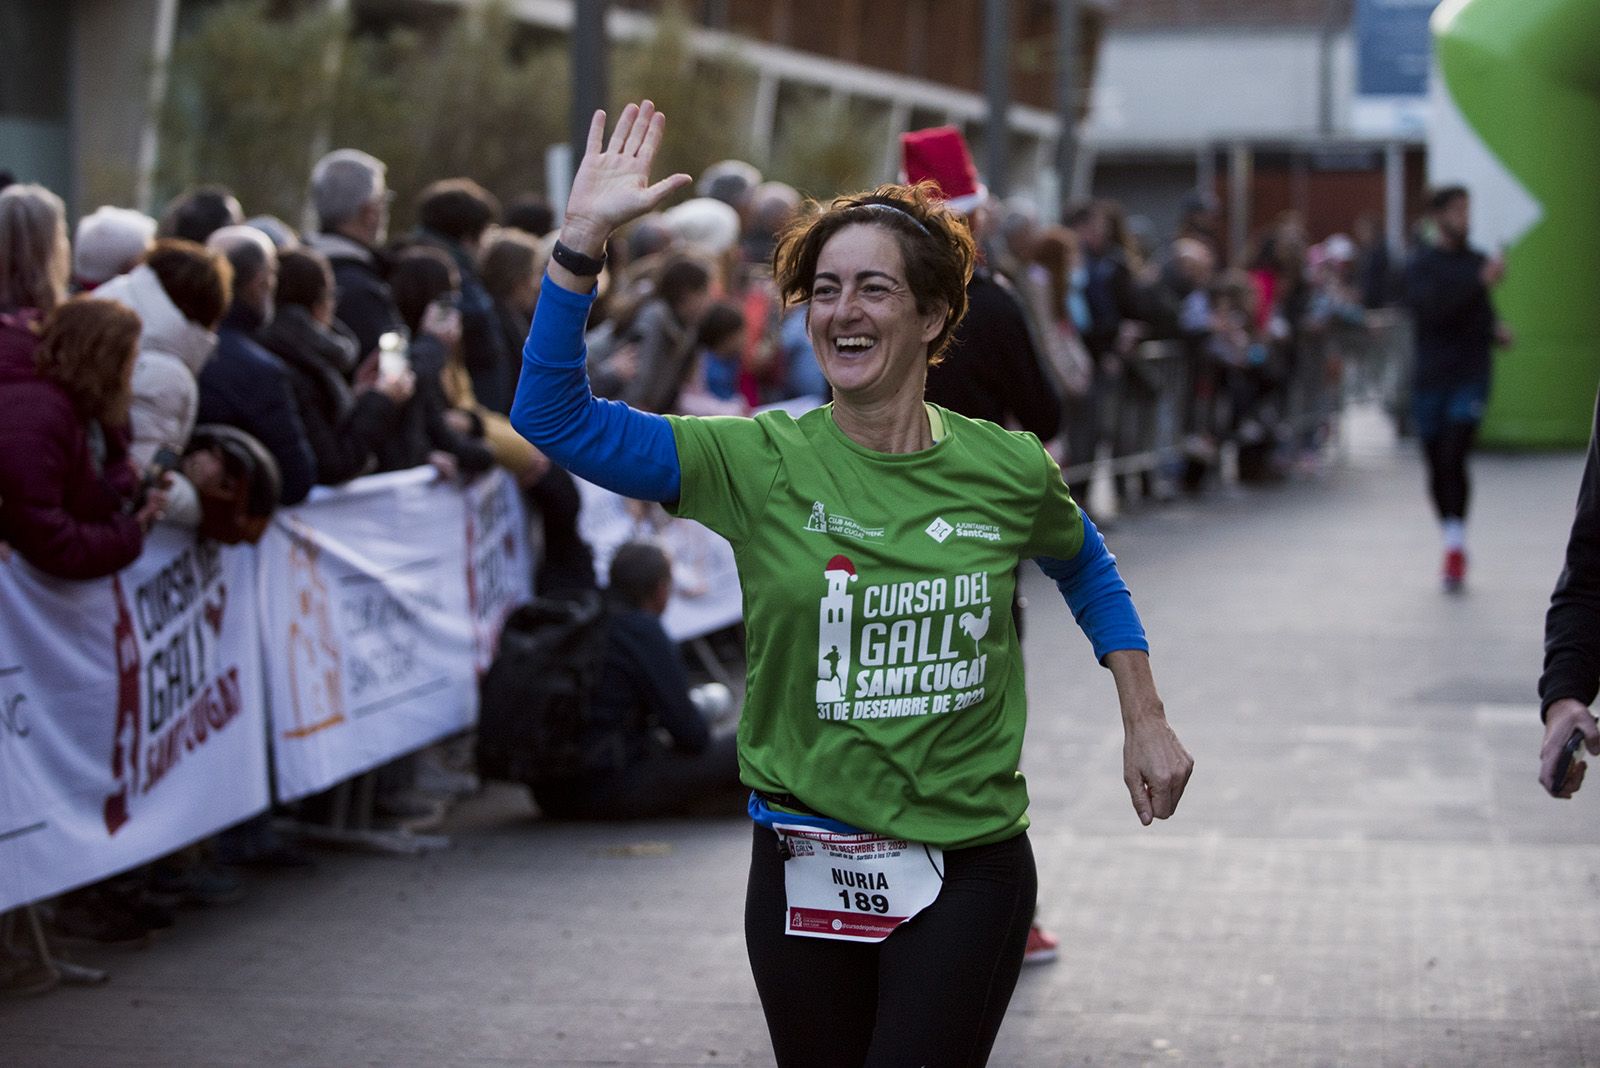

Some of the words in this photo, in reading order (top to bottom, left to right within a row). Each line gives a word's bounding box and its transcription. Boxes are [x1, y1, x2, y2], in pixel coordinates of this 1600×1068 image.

[956, 528, 1001, 541] SantCugat
[863, 578, 947, 619] CURSA
[954, 571, 992, 608] DEL
[859, 614, 960, 667] GALL
[854, 666, 919, 699] SANT
[919, 653, 987, 693] CUGAT
[816, 703, 831, 720] 31
[833, 702, 850, 721] DE
[852, 696, 930, 720] DESEMBRE
[932, 694, 952, 714] DE
[952, 687, 986, 712] 2023
[838, 842, 875, 855] DESEMBRE
[877, 842, 887, 852] DE
[888, 840, 908, 850] 2023
[831, 868, 890, 890] NURIA
[838, 889, 890, 914] 189
